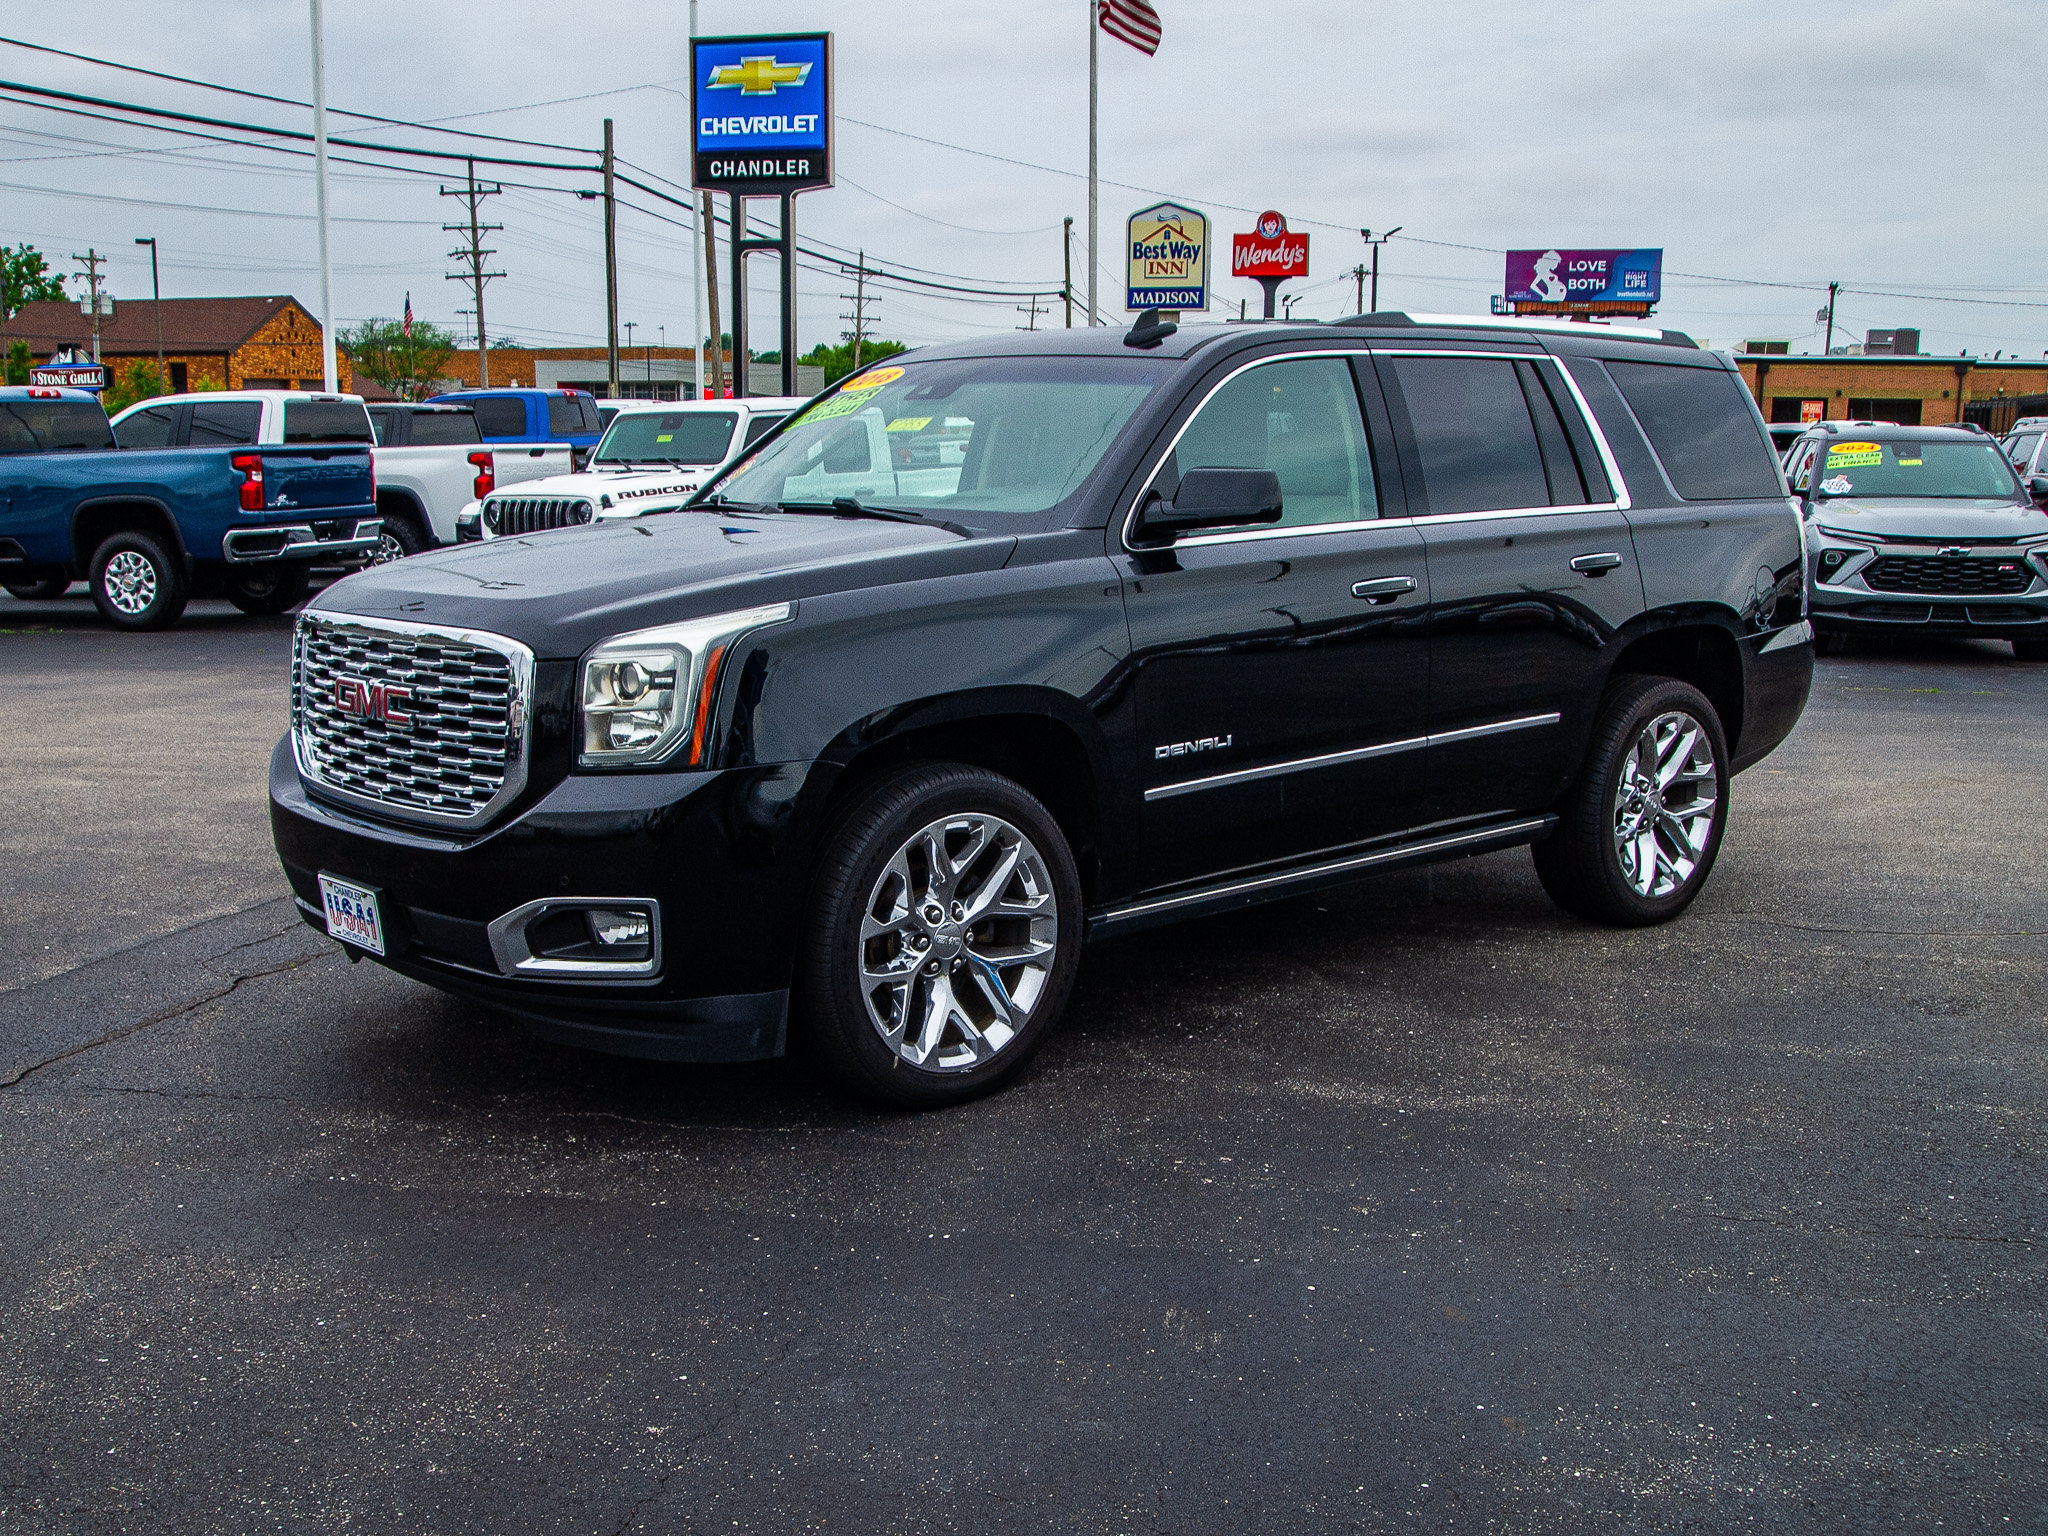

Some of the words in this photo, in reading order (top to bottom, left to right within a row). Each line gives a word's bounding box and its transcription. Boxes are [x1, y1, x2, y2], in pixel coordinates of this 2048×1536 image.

[701, 114, 819, 135] CHEVROLET
[710, 159, 810, 177] CHANDLER
[1133, 241, 1168, 260] Best
[1169, 240, 1201, 265] Way
[1234, 239, 1305, 271] Wendy's
[1148, 261, 1185, 275] INN
[1568, 260, 1607, 272] LOVE
[1568, 278, 1606, 290] BOTH
[1625, 280, 1647, 288] LIFE
[1132, 291, 1200, 305] MADISON
[37, 372, 68, 385] STONE
[69, 371, 98, 385] GRILL
[1836, 444, 1876, 452] 2024
[1829, 454, 1854, 462] EXTRA
[1843, 458, 1880, 466] FINANCE
[617, 484, 698, 500] RUBICON
[335, 675, 414, 725] GMC
[1155, 734, 1232, 759] DENALI
